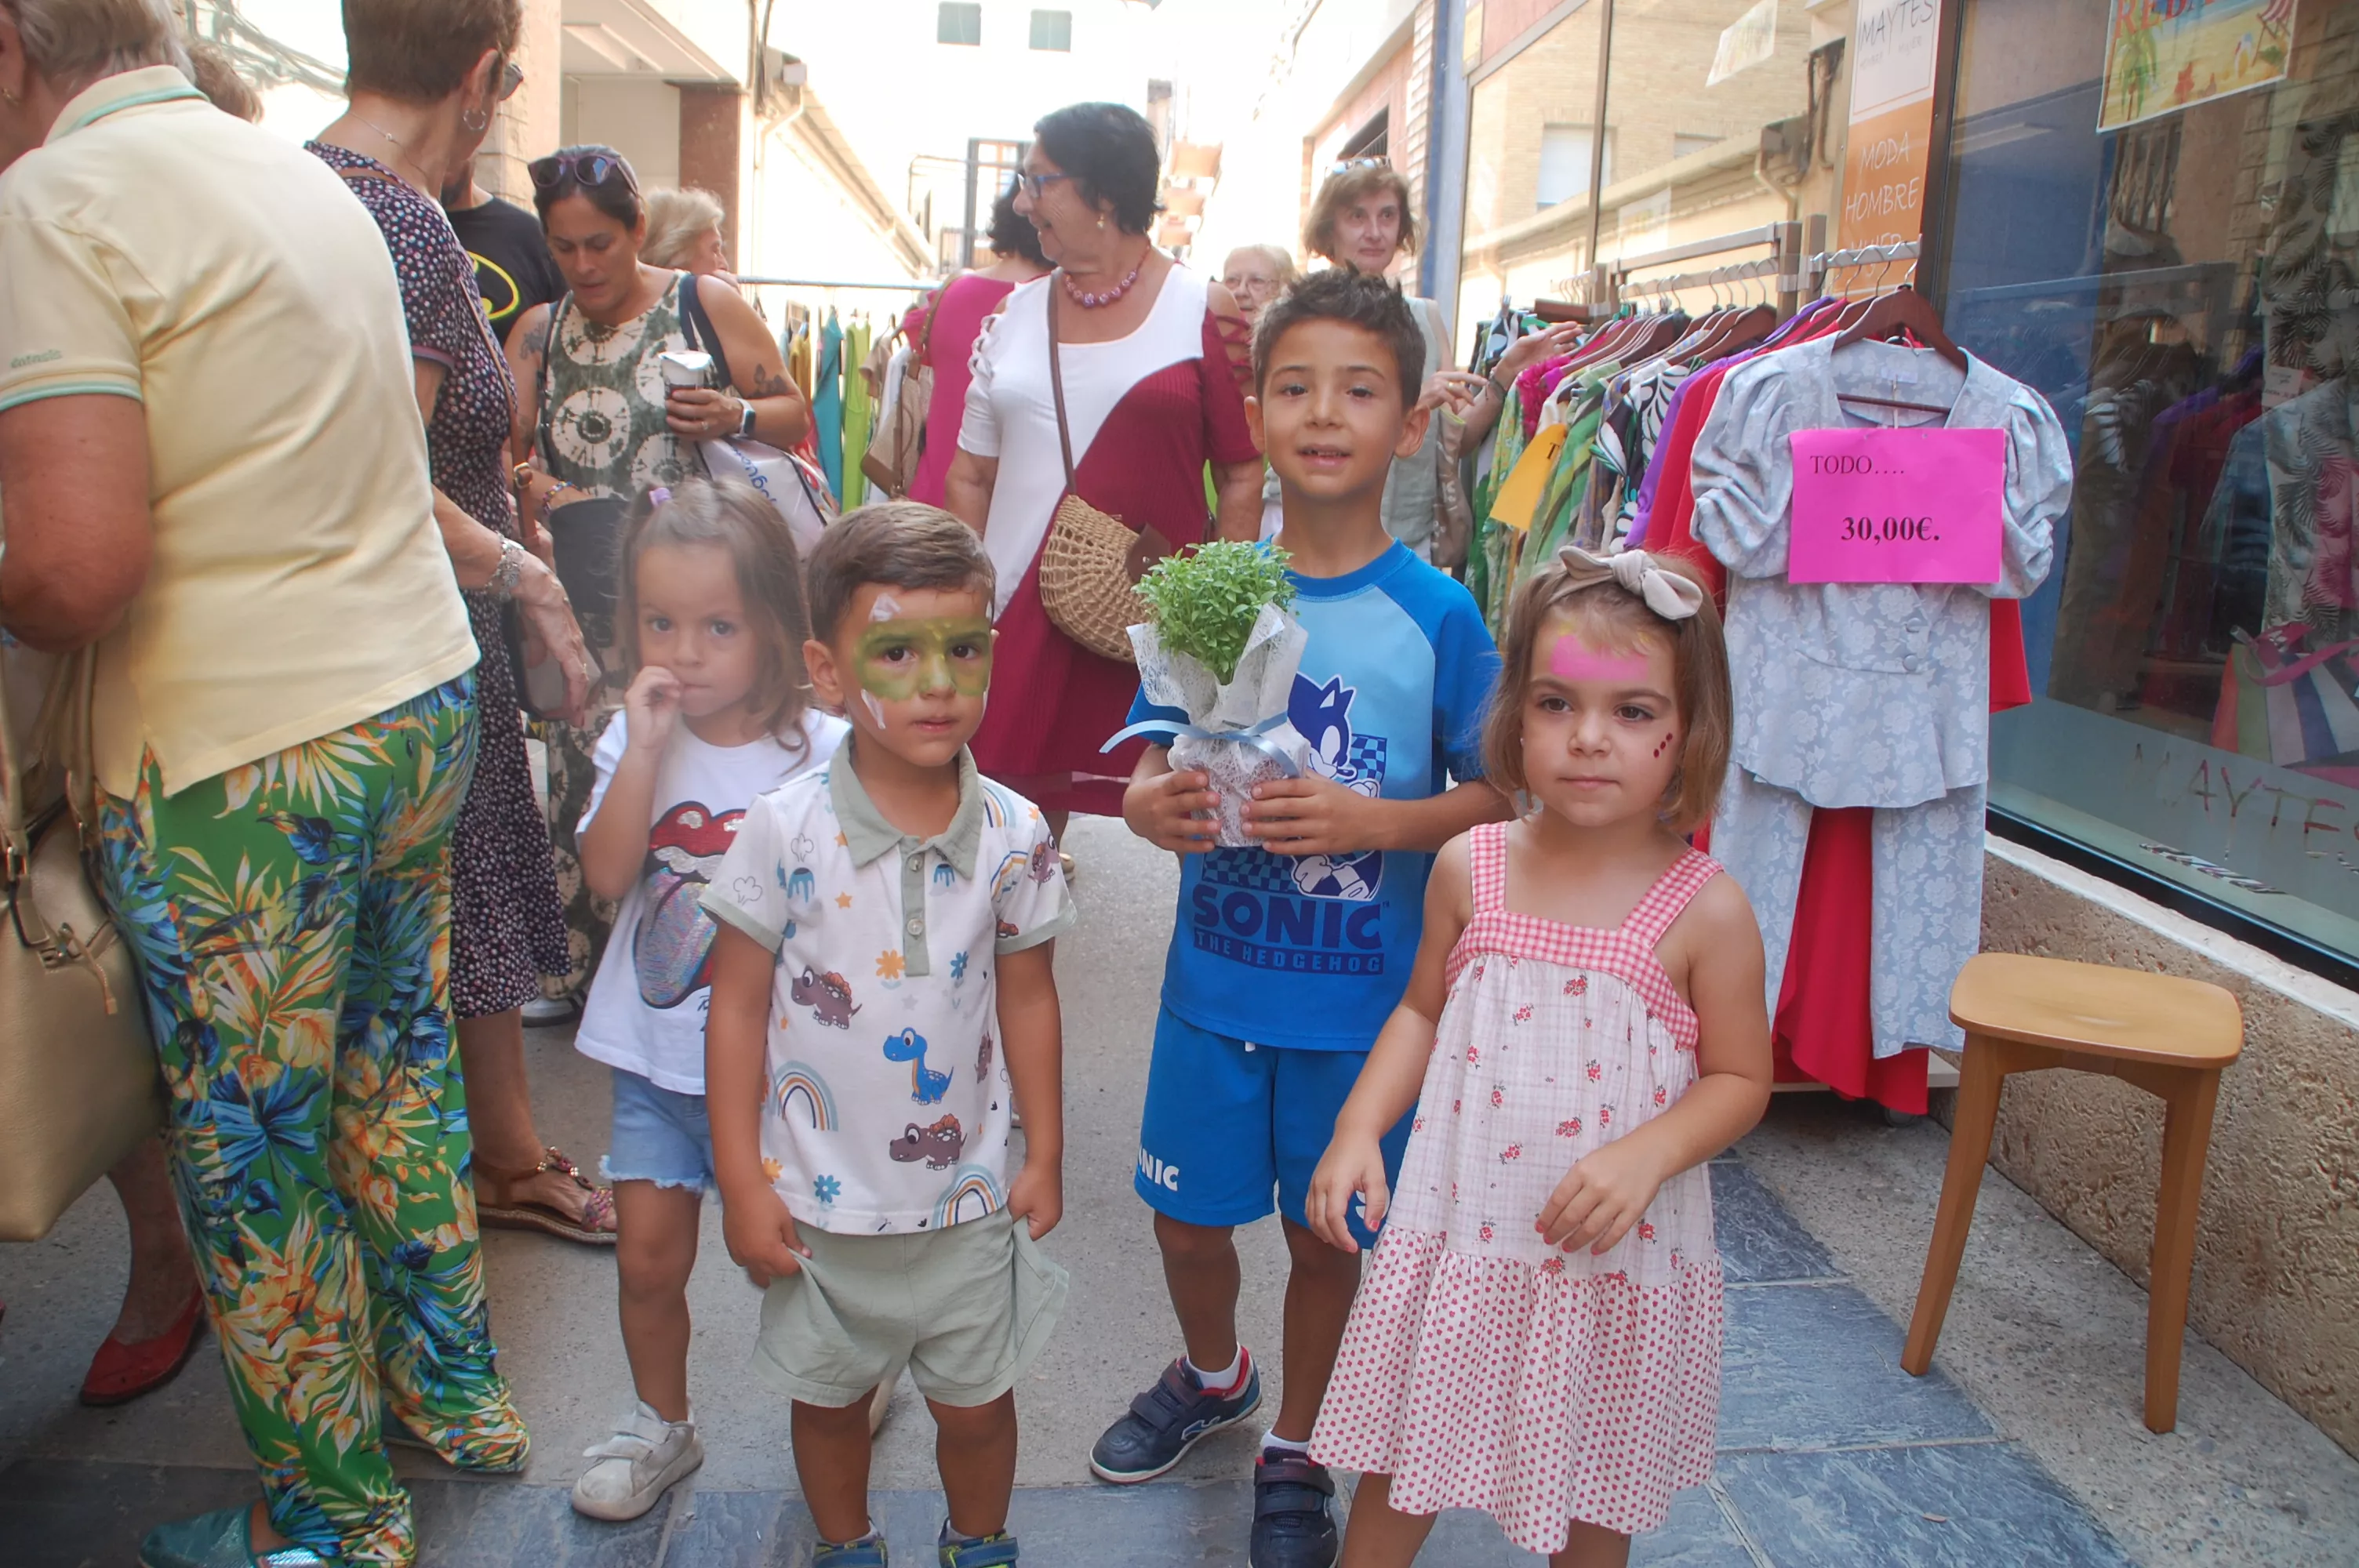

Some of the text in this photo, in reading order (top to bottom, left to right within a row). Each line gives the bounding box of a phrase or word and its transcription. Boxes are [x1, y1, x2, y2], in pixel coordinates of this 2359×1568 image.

[1859, 131, 1910, 174] MODA
[1845, 176, 1920, 223] HOMBRE
[1841, 517, 1940, 546] 30,00€.
[1192, 884, 1383, 950] SONIC
[1195, 930, 1380, 973] THE HEDGEHOG
